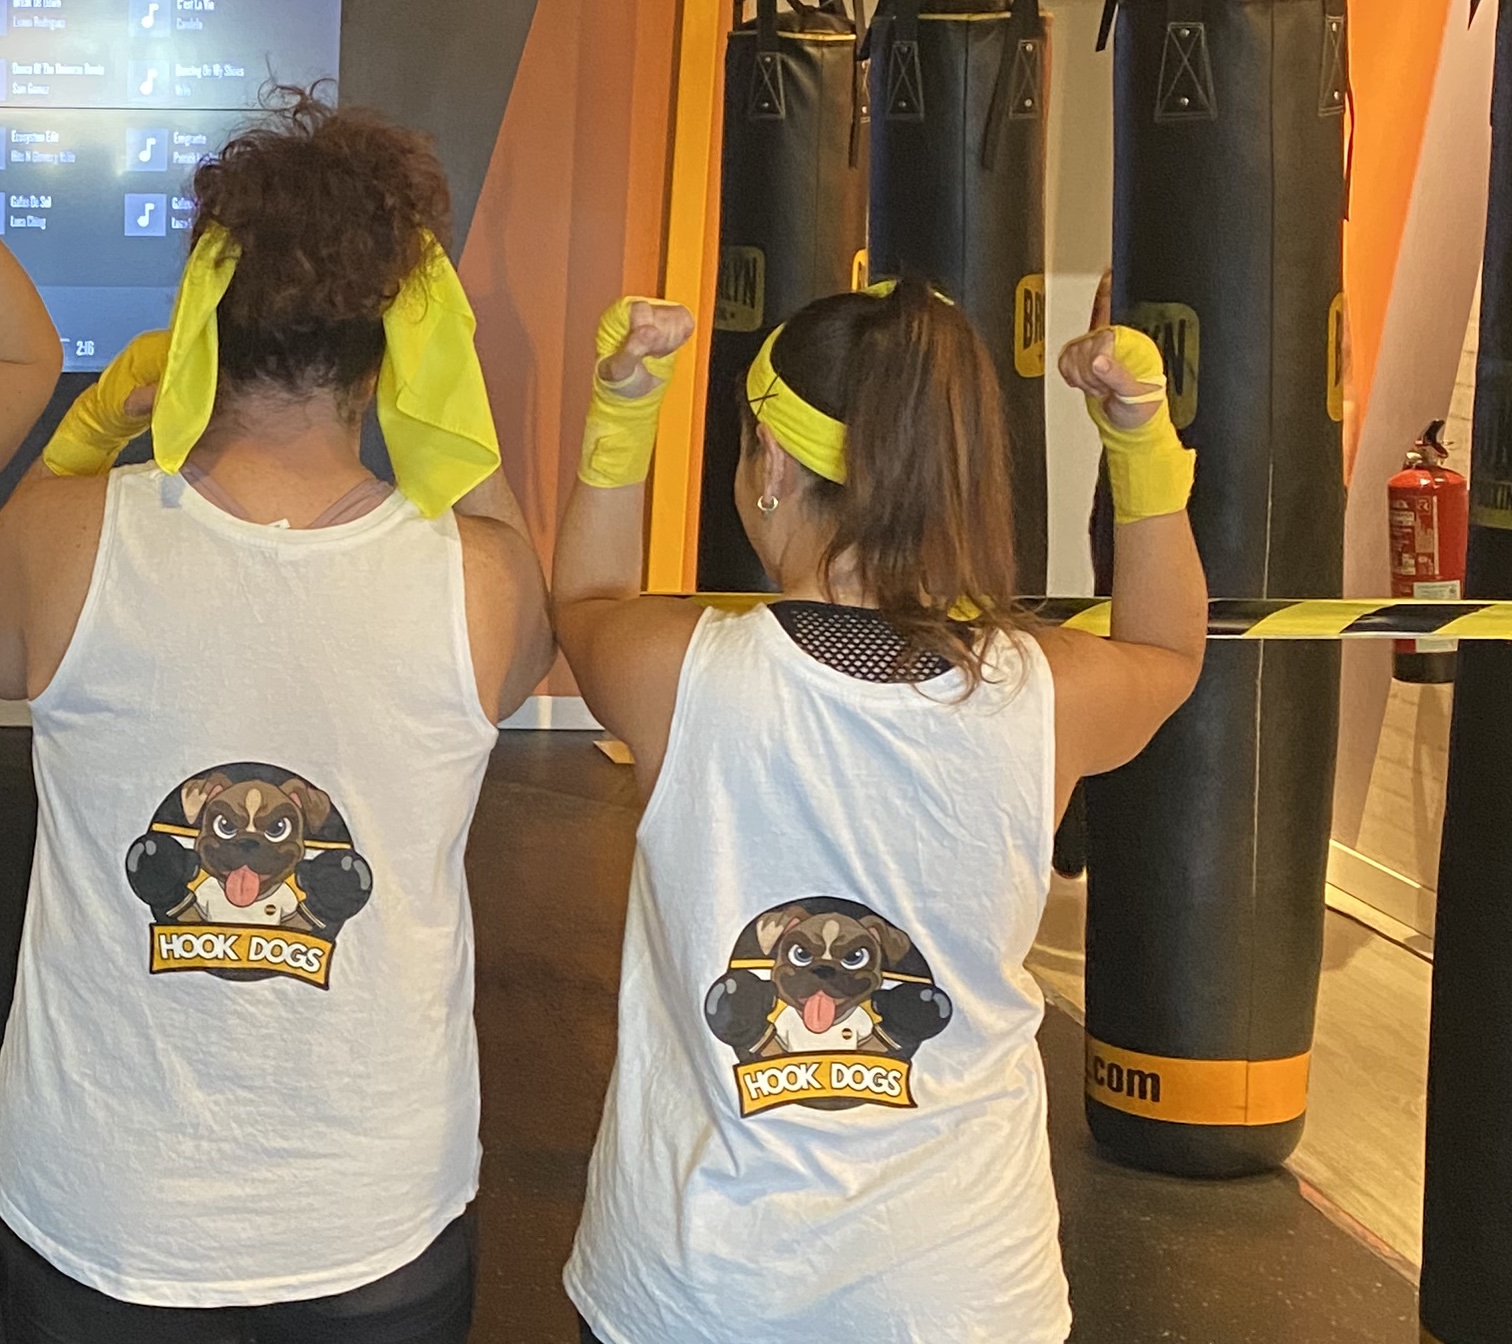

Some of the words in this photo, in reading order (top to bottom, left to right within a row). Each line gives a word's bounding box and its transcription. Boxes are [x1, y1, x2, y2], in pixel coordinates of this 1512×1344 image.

[76, 340, 94, 356] 2:16
[158, 932, 241, 962] HOOK
[247, 935, 325, 974] DOGS
[743, 1062, 824, 1100] HOOK
[829, 1062, 903, 1097] DOGS
